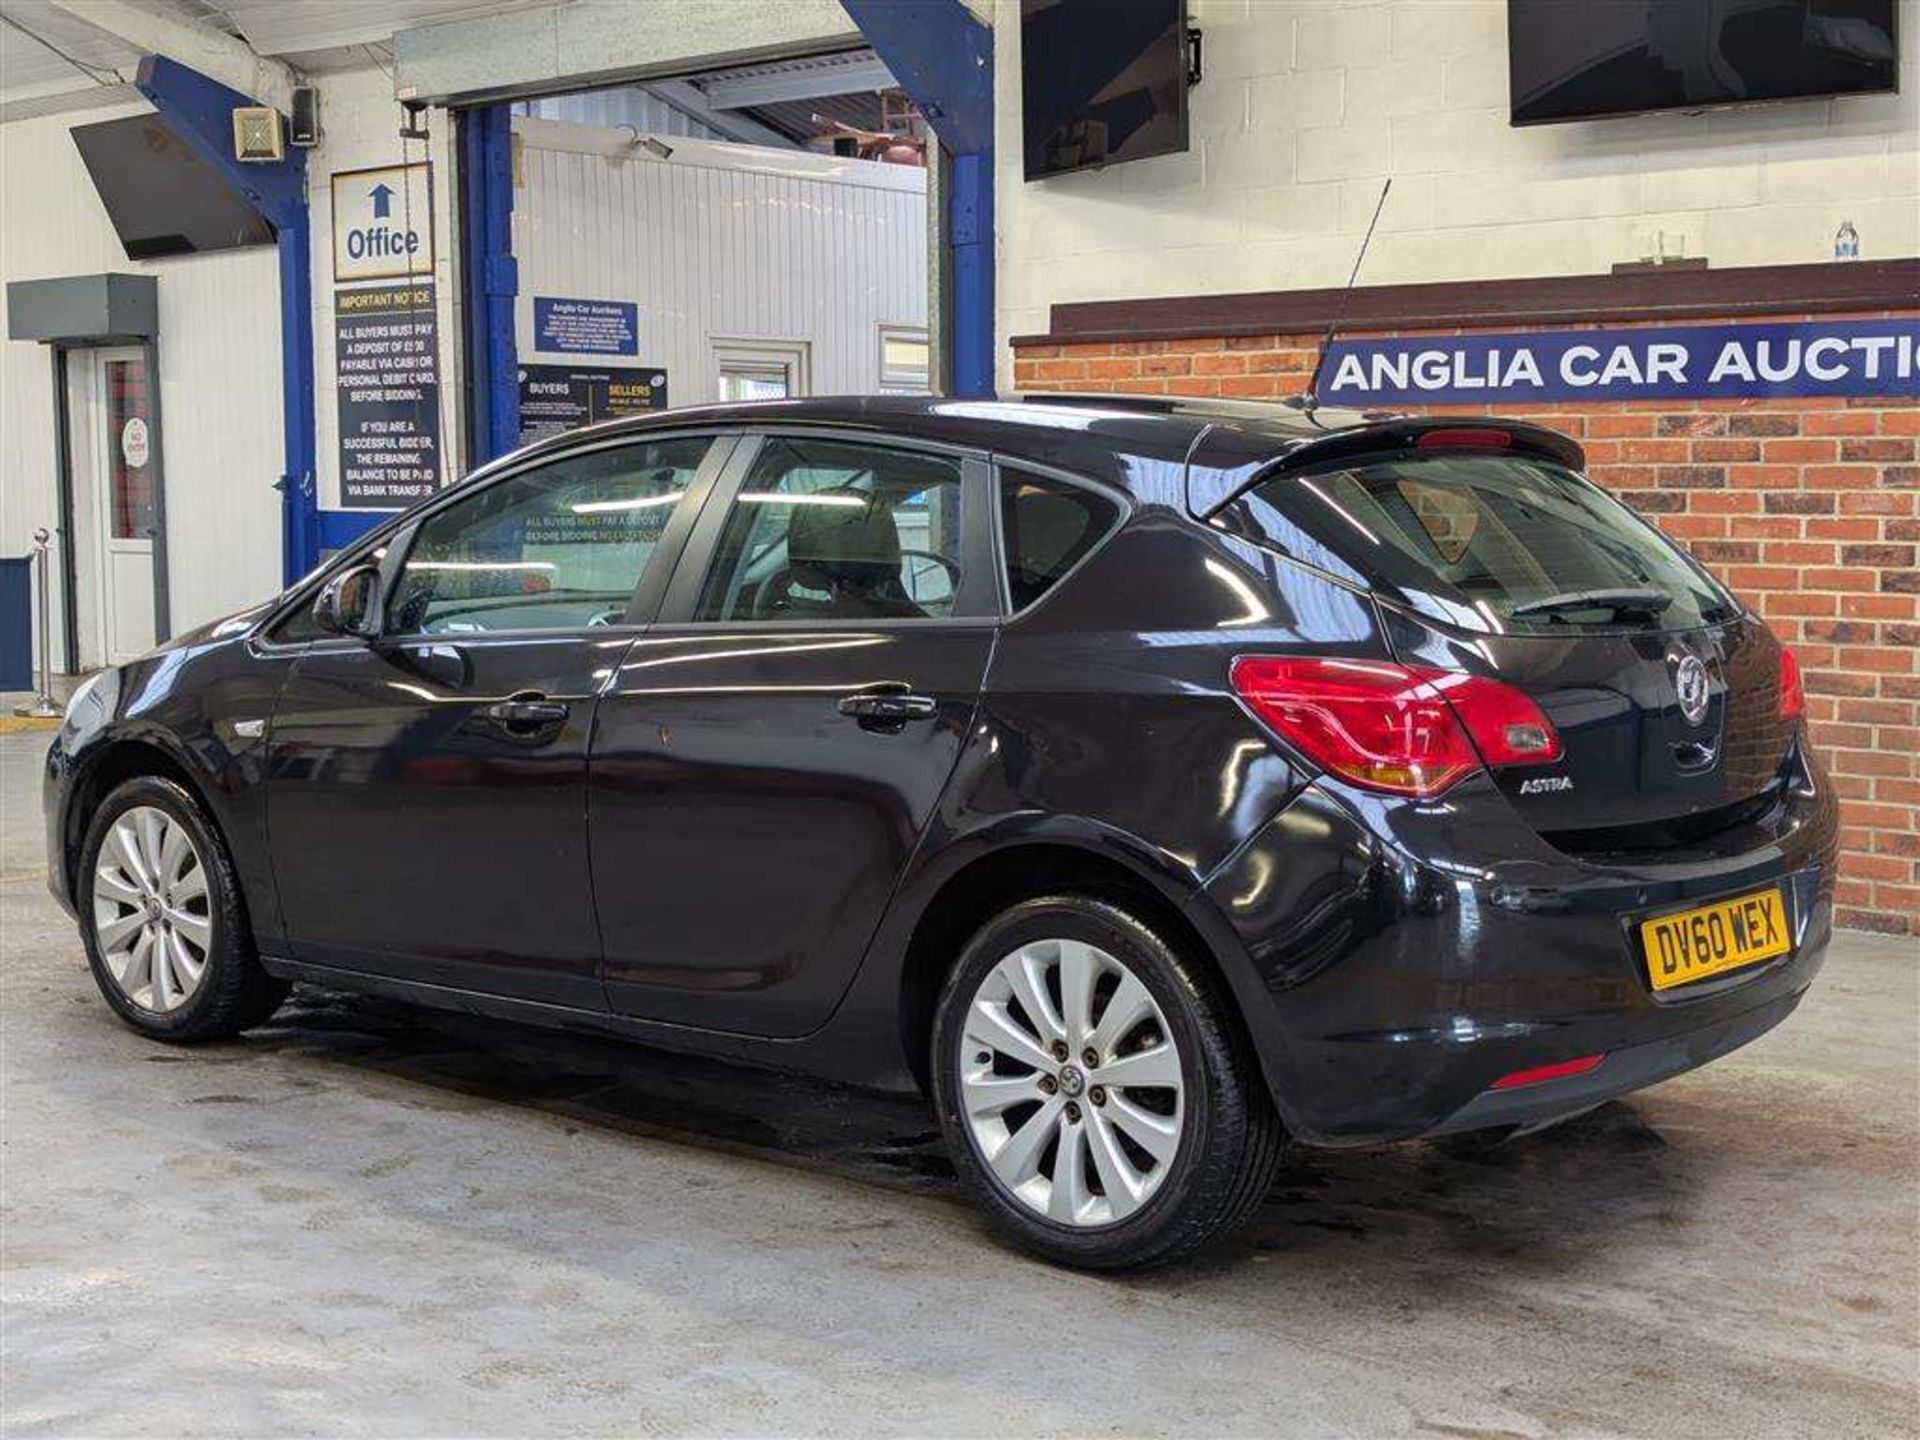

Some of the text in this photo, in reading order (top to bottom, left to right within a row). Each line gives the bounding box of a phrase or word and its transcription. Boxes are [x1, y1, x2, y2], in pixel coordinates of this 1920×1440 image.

[347, 226, 419, 259] Office
[340, 293, 392, 308] IMPORTANT
[577, 304, 590, 314] Car
[340, 324, 433, 339] ALL BUYERS MUST PAY
[347, 345, 353, 354] A
[354, 342, 389, 354] DEPOSIT
[391, 341, 402, 352] OF
[341, 358, 377, 371] PAYABLE
[378, 357, 393, 369] VIA
[419, 355, 434, 367] OR
[1330, 336, 1920, 391] ANGLIA CAR AUCTI
[339, 374, 381, 387] PERSONAL
[382, 373, 407, 385] DEBIT
[529, 382, 570, 395] BUYERS
[608, 385, 651, 397] SELLERS
[350, 390, 383, 402] BEFORE
[361, 421, 415, 432] IF YOU ARE A
[343, 437, 397, 449] SUCCESSFUL
[356, 453, 421, 464] THE REMAINING
[346, 469, 385, 480] BALANCE
[387, 469, 398, 480] TO
[399, 469, 411, 480] BE
[347, 485, 434, 496] VIA BANK TRANSFER
[1520, 776, 1573, 794] ASTRA
[1655, 897, 1778, 974] DV60 WEX
